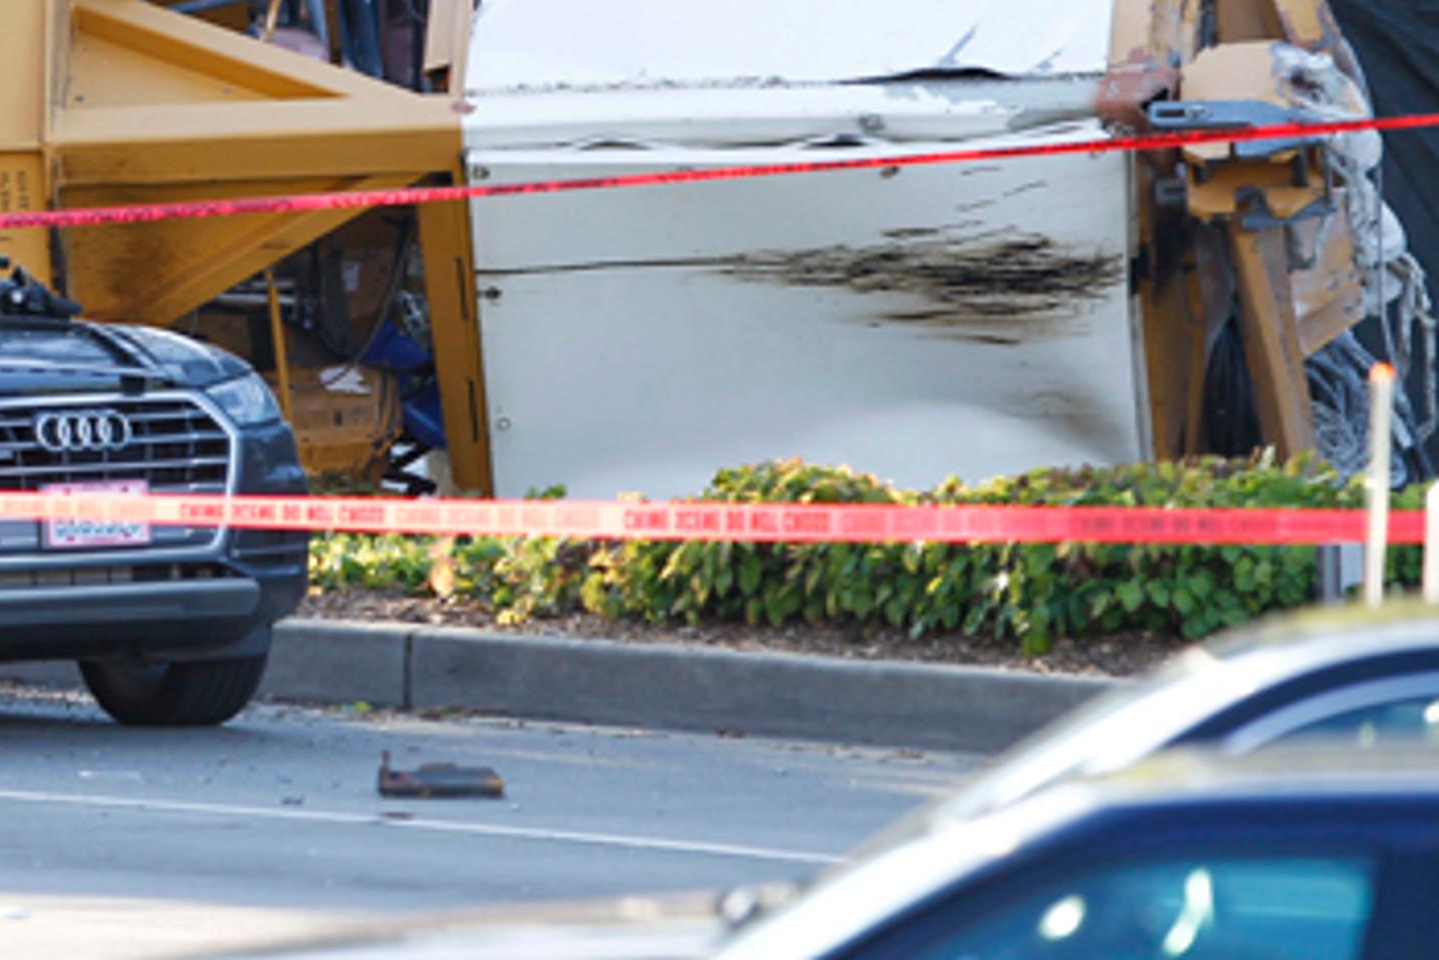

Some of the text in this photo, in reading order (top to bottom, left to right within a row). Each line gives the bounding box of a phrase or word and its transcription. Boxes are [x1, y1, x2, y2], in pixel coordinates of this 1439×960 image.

[624, 510, 668, 529] CRIME
[675, 511, 720, 531] SCENE
[727, 511, 745, 531] DO
